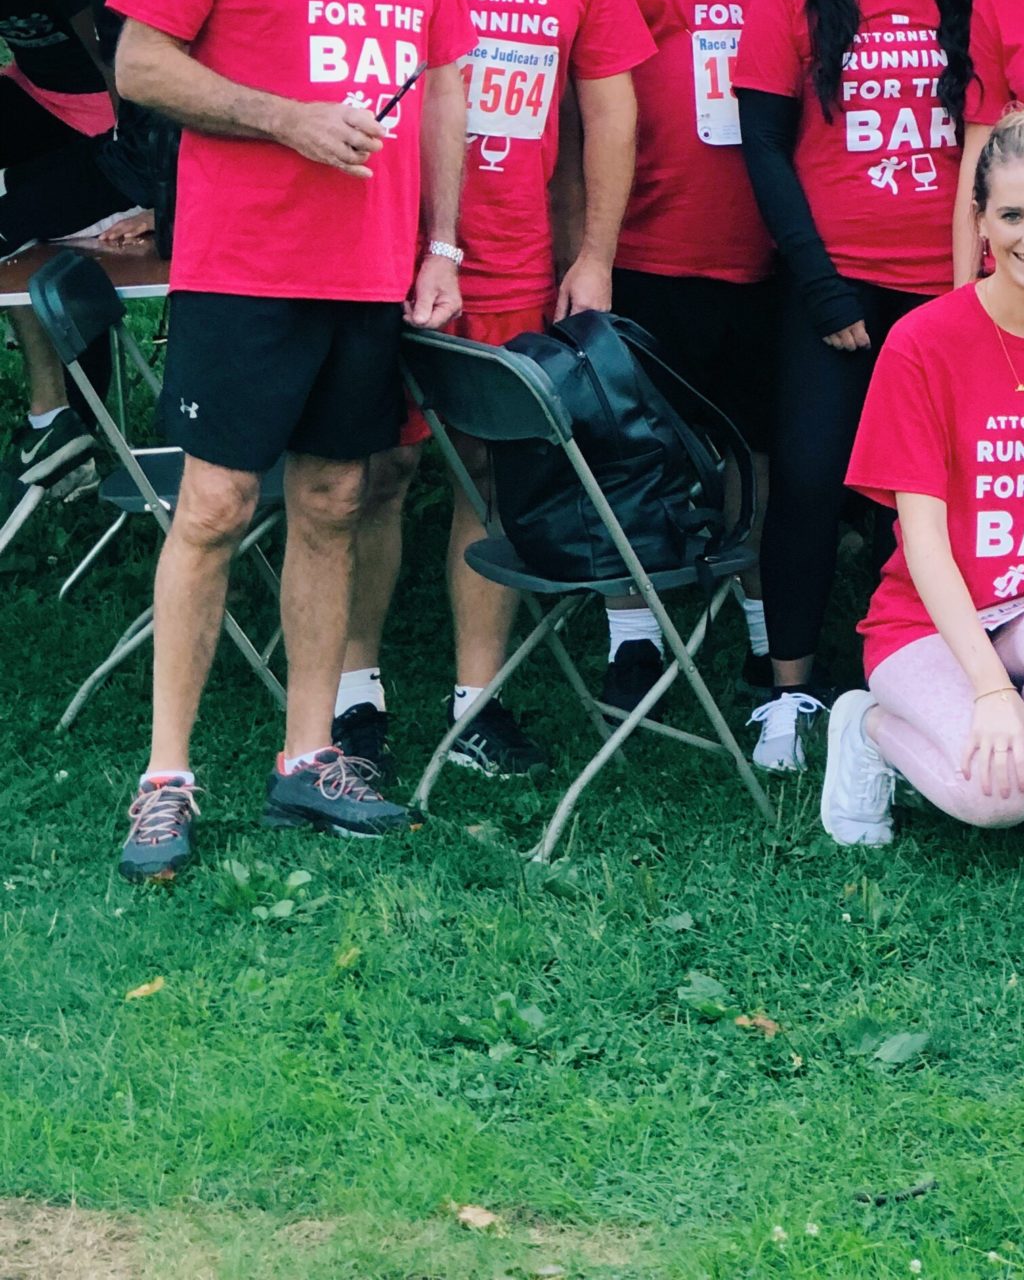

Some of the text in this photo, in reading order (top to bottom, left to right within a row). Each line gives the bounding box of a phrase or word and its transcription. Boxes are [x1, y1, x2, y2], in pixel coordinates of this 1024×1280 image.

[308, 1, 423, 32] FOR THE
[470, 11, 559, 37] NNING
[695, 4, 744, 25] FOR
[699, 38, 727, 51] Race
[854, 30, 936, 42] ATTORNEY
[310, 36, 418, 90] BAR
[491, 47, 539, 66] Judicata
[843, 50, 948, 70] RUNNIN
[460, 63, 546, 118] 1564
[844, 79, 901, 100] FOR
[847, 108, 956, 151] BAR
